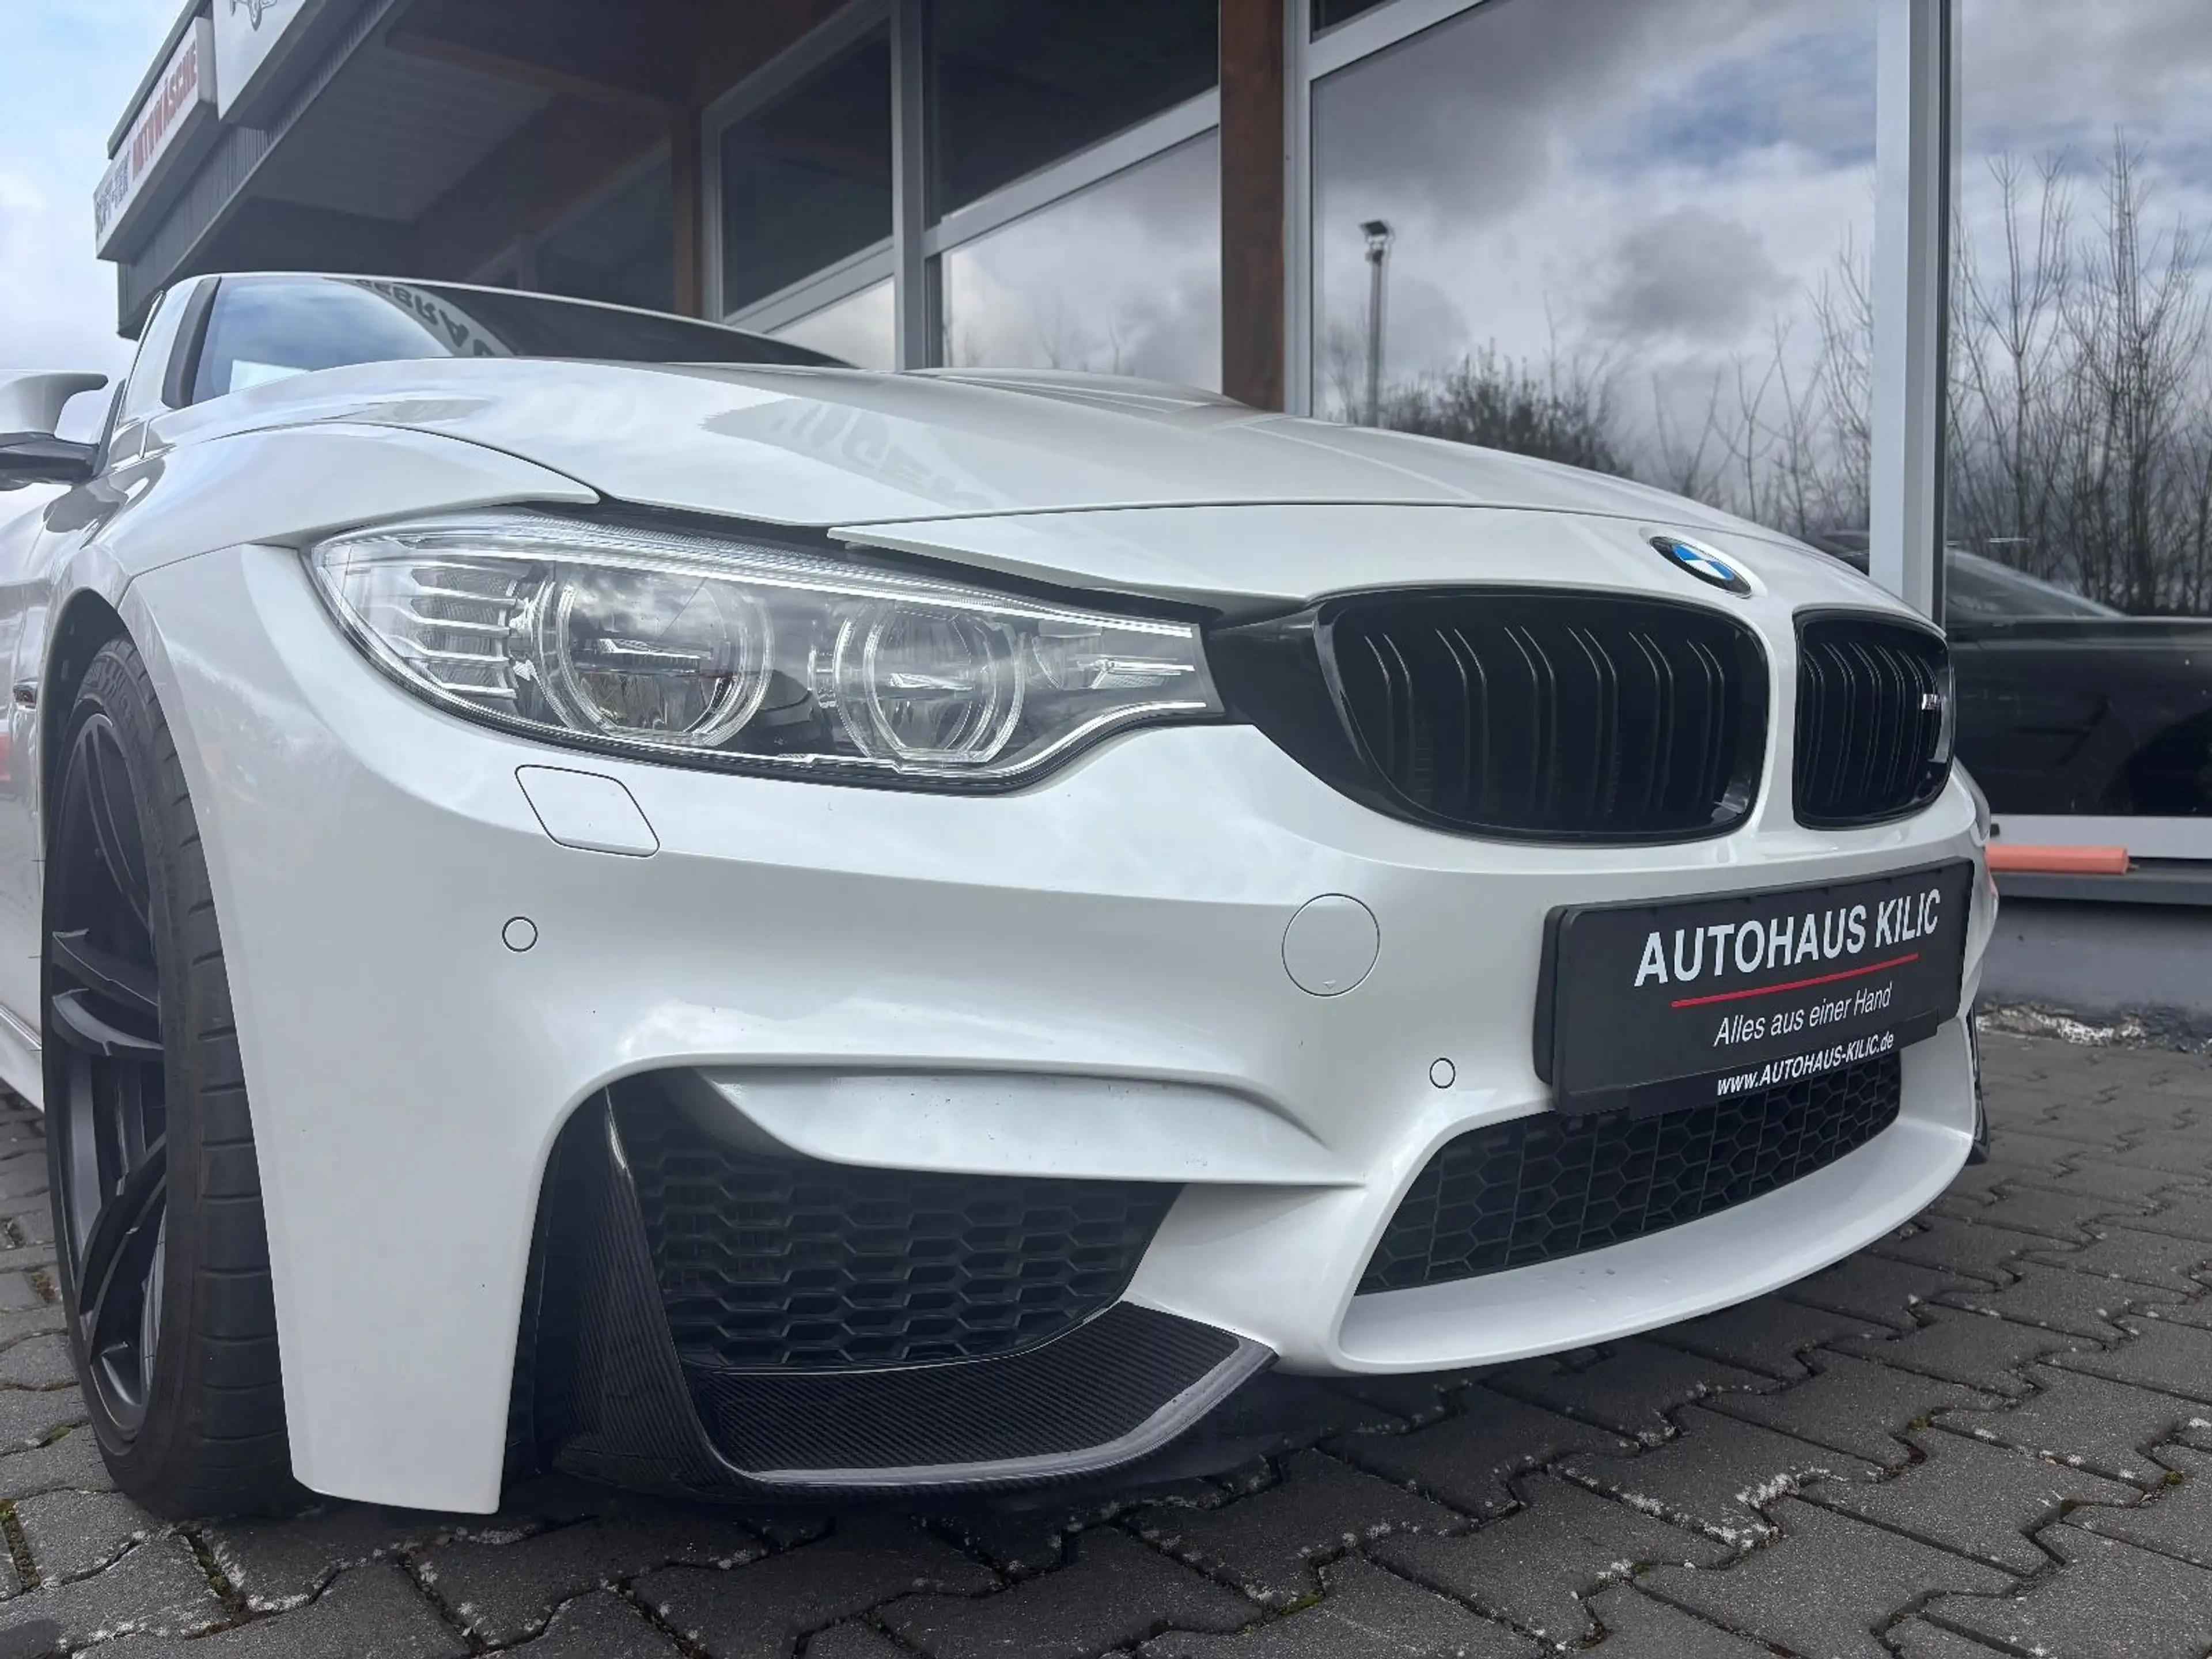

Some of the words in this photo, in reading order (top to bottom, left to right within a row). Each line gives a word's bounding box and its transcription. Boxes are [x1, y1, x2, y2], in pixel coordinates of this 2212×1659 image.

[1634, 904, 1867, 987] AUTOHAUS
[1874, 889, 1941, 948] KILIC
[1713, 1014, 1766, 1047] Alles
[1771, 1009, 1805, 1036] aus
[1809, 998, 1852, 1027] einer
[1854, 981, 1893, 1016] Hand
[1717, 1031, 1894, 1096] www.AUTOHAUS-KILIC.de
